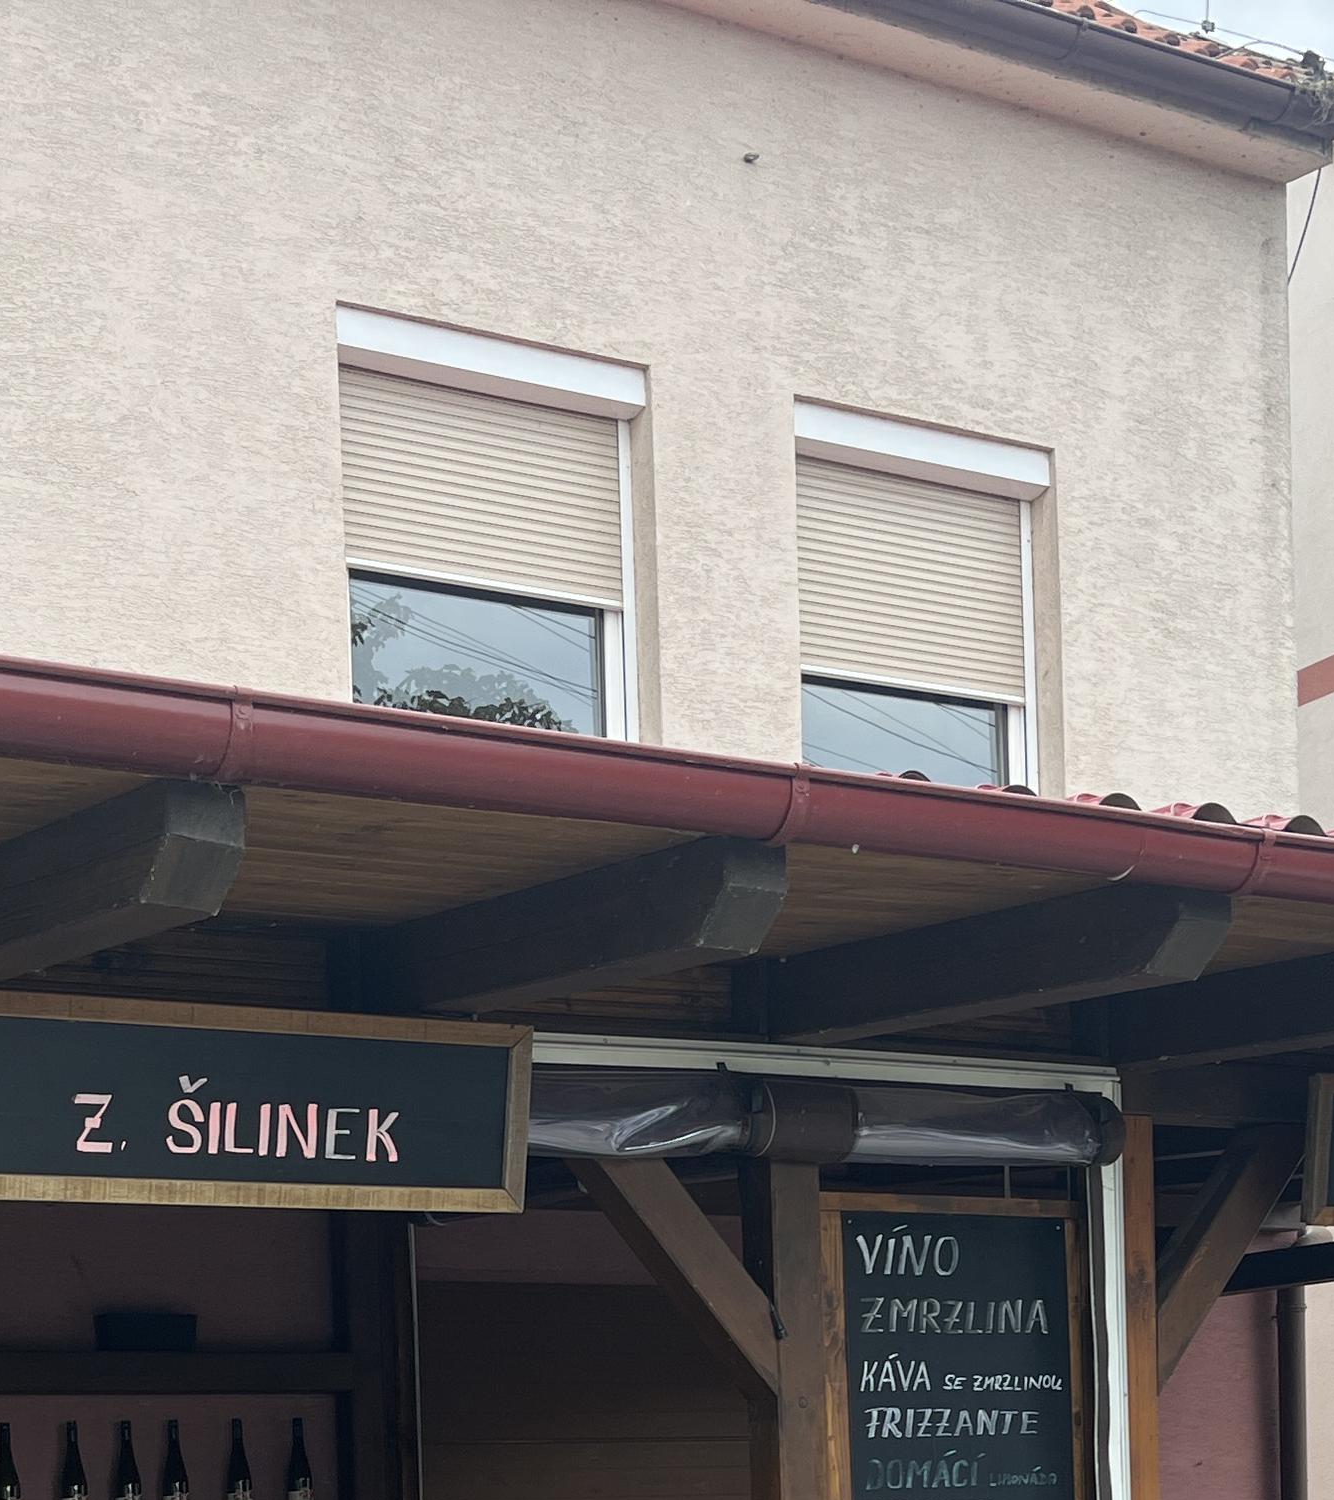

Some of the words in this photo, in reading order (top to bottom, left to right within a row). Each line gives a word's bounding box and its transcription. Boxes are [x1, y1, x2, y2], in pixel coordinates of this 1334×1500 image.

[166, 1074, 400, 1162] ŠILINEK
[855, 1224, 961, 1277] VÍNO
[860, 1296, 1050, 1335] ZMRZLINA
[859, 1352, 932, 1392] KÁVA
[942, 1373, 967, 1391] SE
[972, 1373, 1064, 1392] ZMRZLINOU
[863, 1406, 1041, 1439] FRIZZANTE
[865, 1449, 987, 1491] DOMÁCÍ
